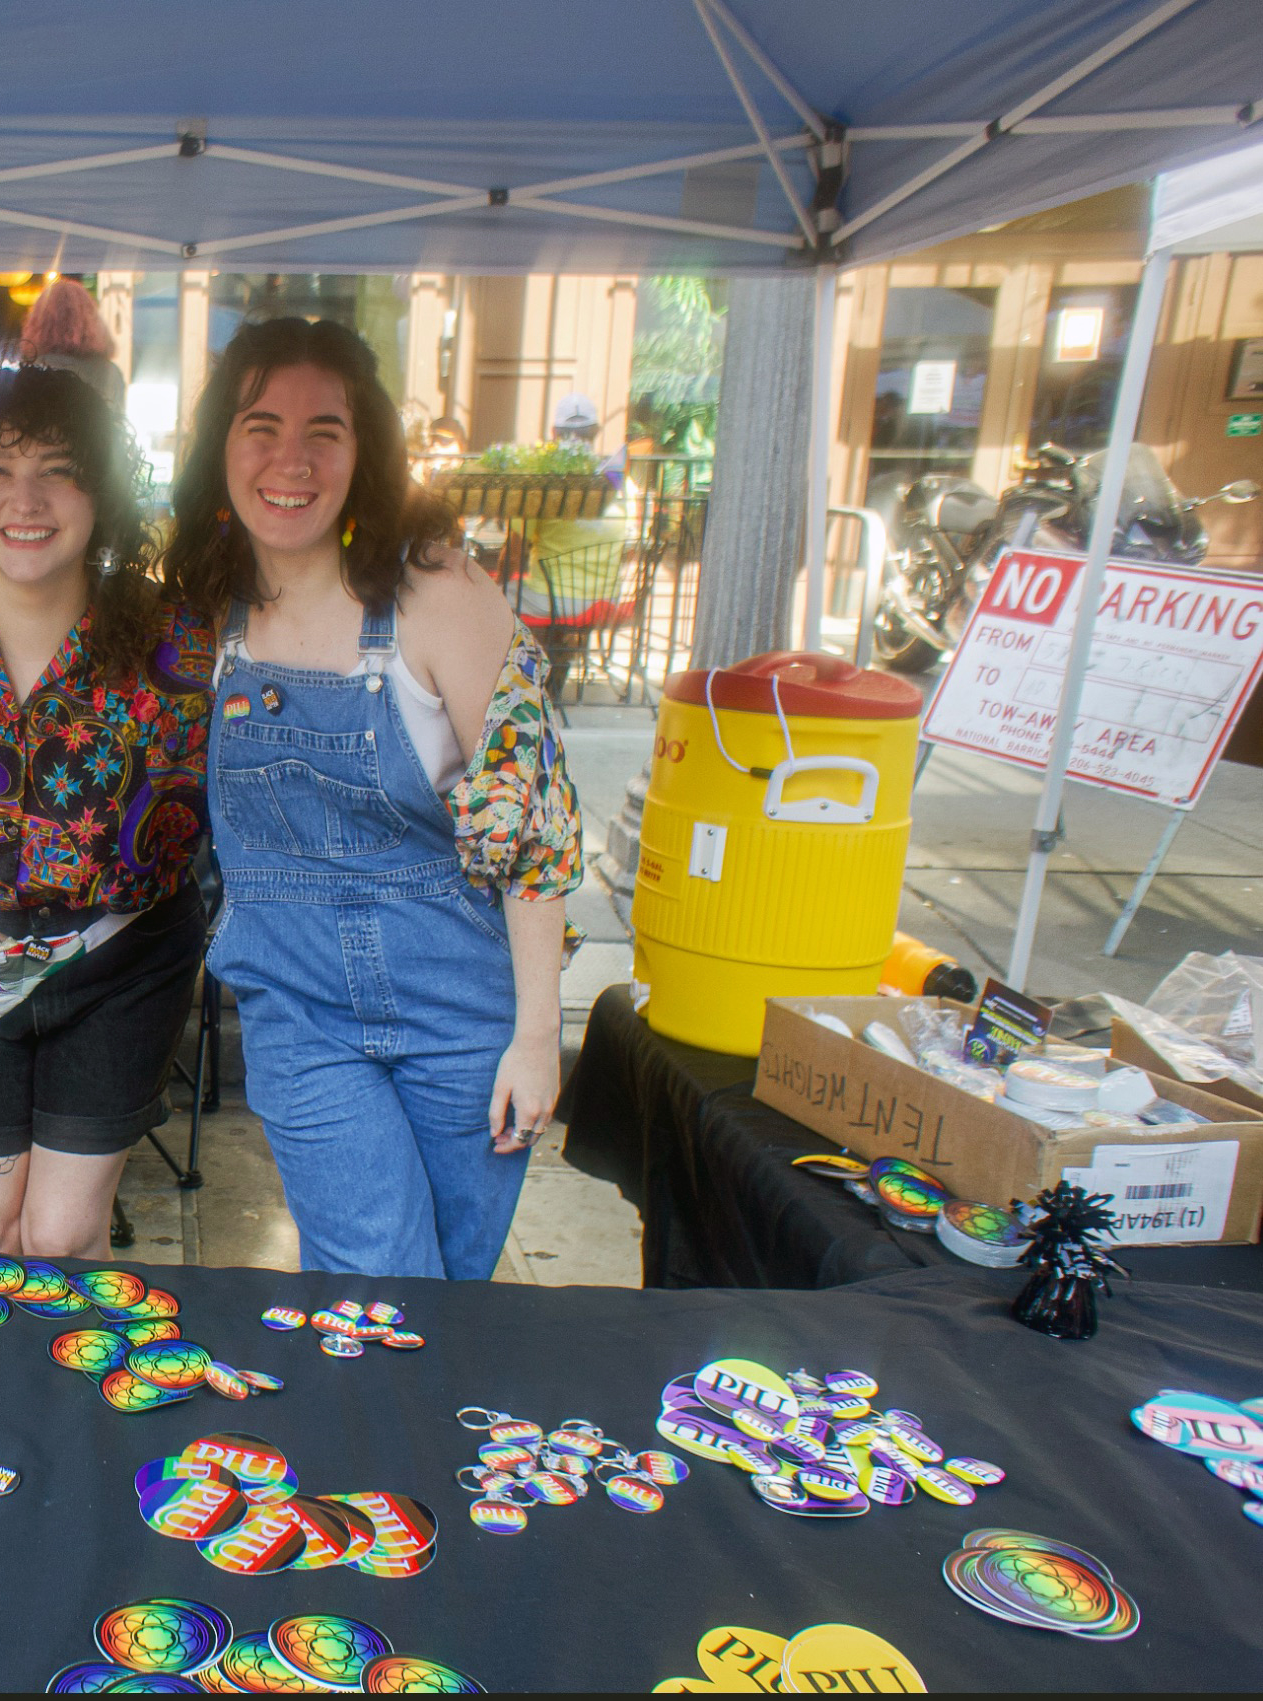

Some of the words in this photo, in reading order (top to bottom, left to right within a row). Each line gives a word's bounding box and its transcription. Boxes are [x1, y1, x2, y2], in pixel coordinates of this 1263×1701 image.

[990, 561, 1064, 616] NO
[1075, 581, 1263, 641] ARKING
[975, 625, 1035, 652] FROM
[976, 665, 1001, 686] TO
[999, 724, 1044, 744] PHONE
[1096, 728, 1156, 757] AREA
[849, 1082, 954, 1166] TENT
[1180, 1205, 1205, 1229] (1)
[265, 1307, 305, 1326] PLU
[314, 1311, 354, 1332] PLU
[709, 1370, 787, 1419] PLU
[497, 1424, 535, 1439] PLU
[196, 1442, 280, 1483] PLU
[537, 1472, 572, 1503] PLU
[613, 1479, 657, 1505] PLU
[154, 1481, 232, 1536] PLU
[356, 1495, 421, 1550] PLU
[476, 1506, 519, 1524] PLU
[209, 1511, 292, 1570] PLU
